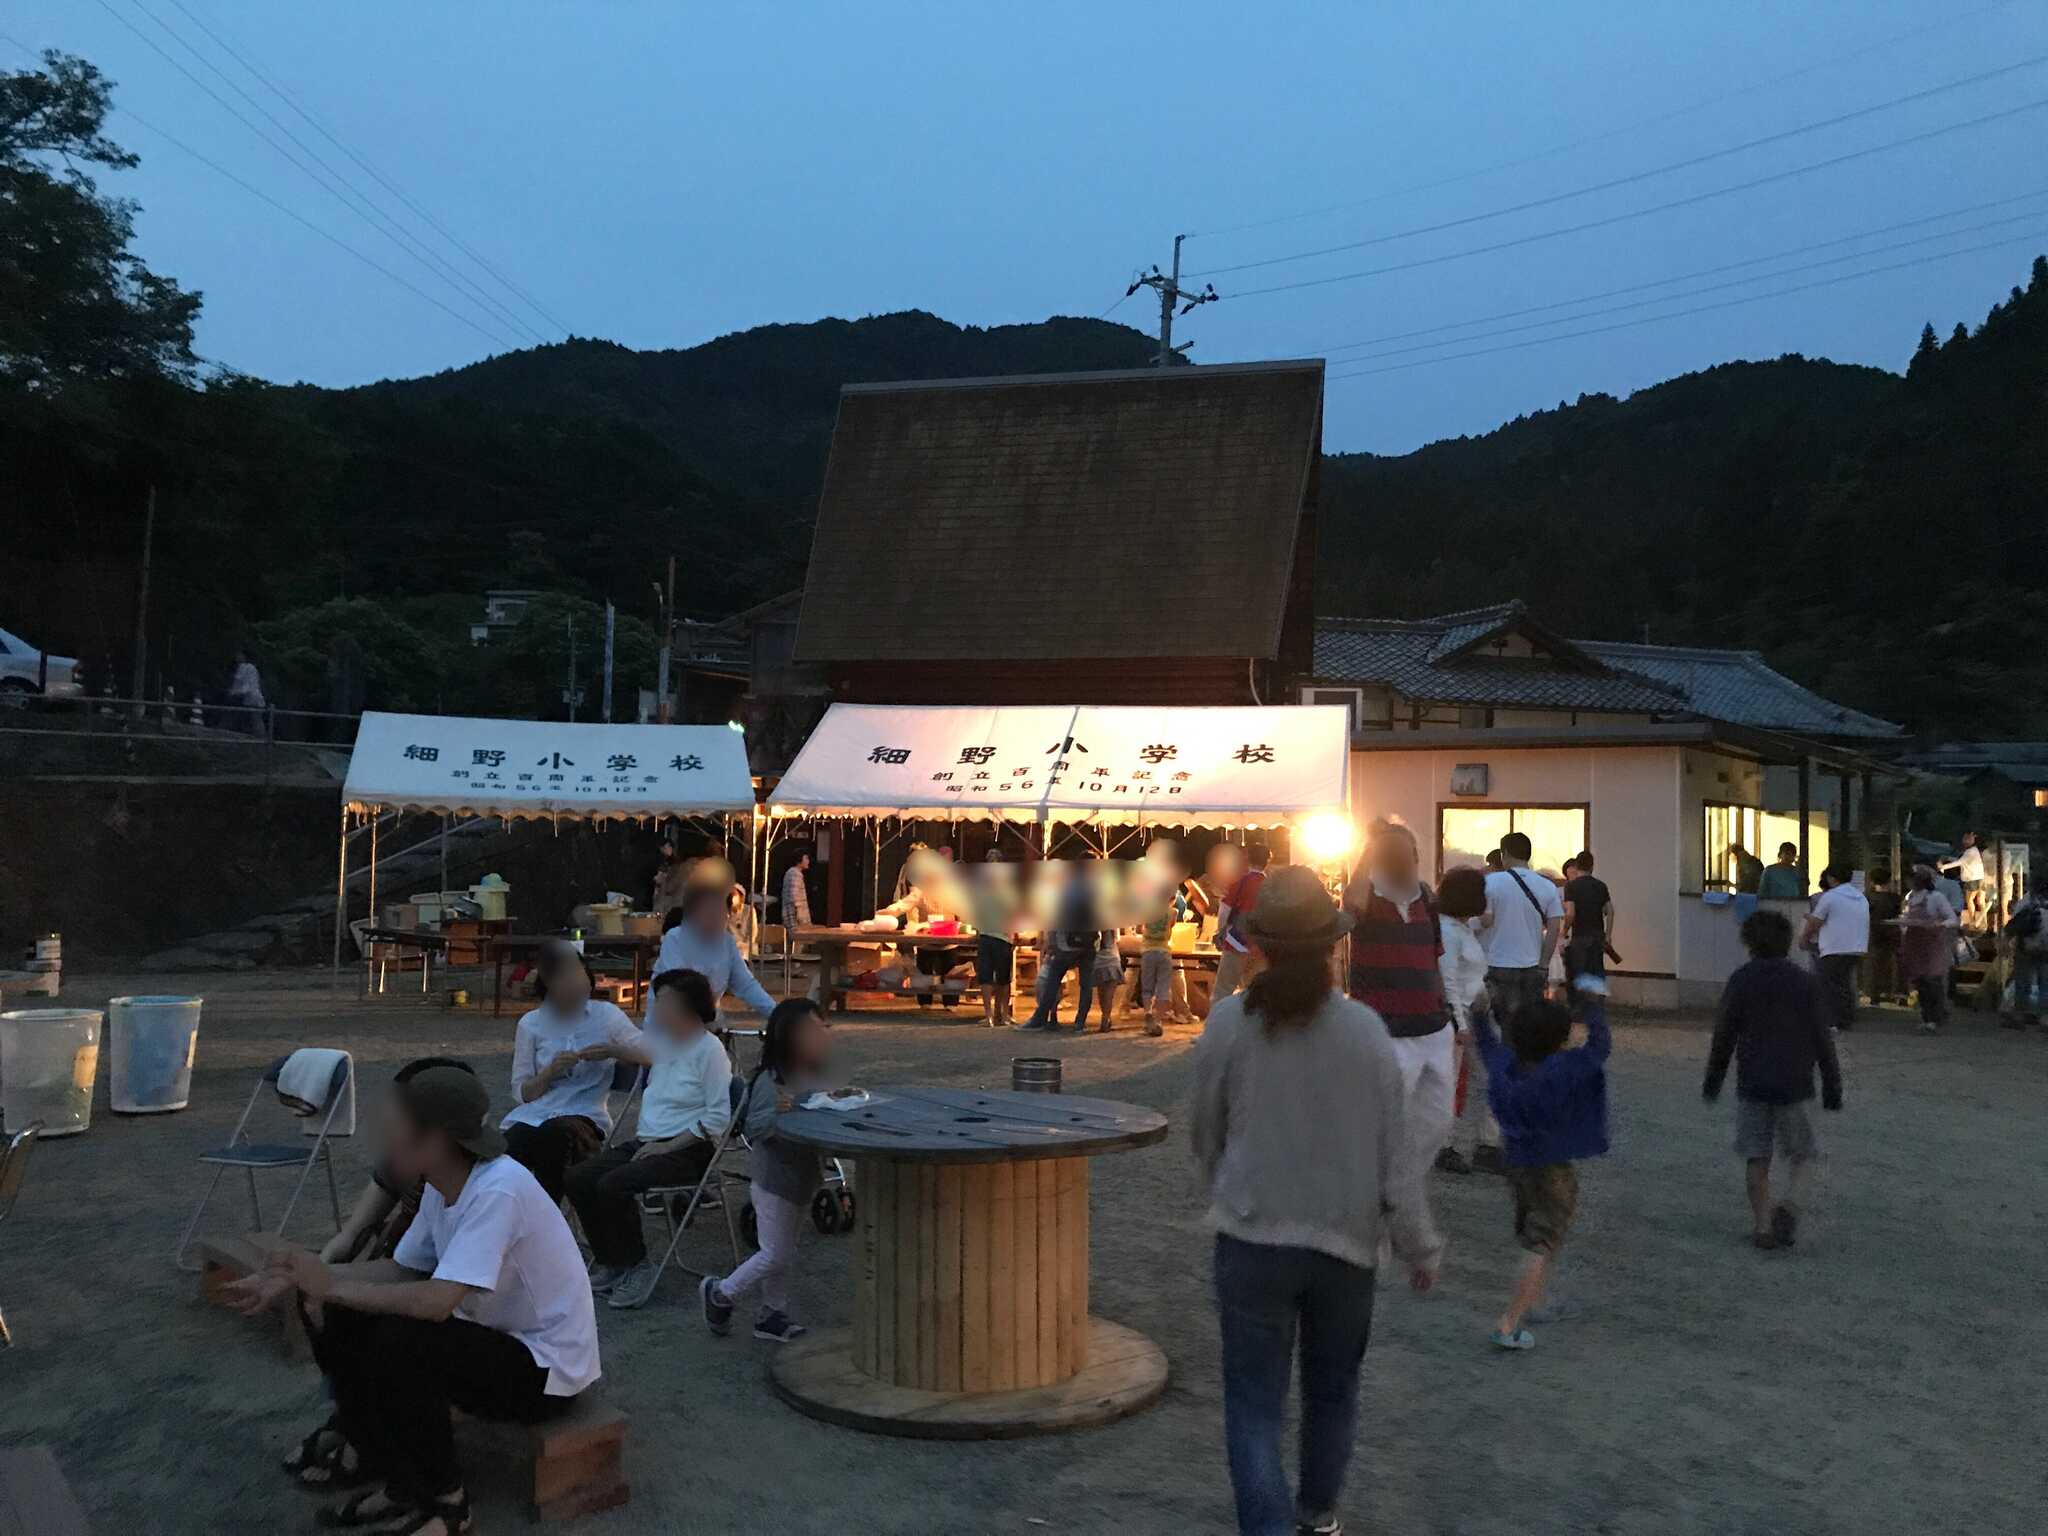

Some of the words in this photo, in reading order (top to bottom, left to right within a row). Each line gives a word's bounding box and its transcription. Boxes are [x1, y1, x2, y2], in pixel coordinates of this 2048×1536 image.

[402, 743, 705, 772] 細野小学校
[867, 736, 1276, 765] 細野小学校
[929, 760, 1193, 782] 創立百周年記念
[945, 776, 1182, 794] 昭和56年10月12日
